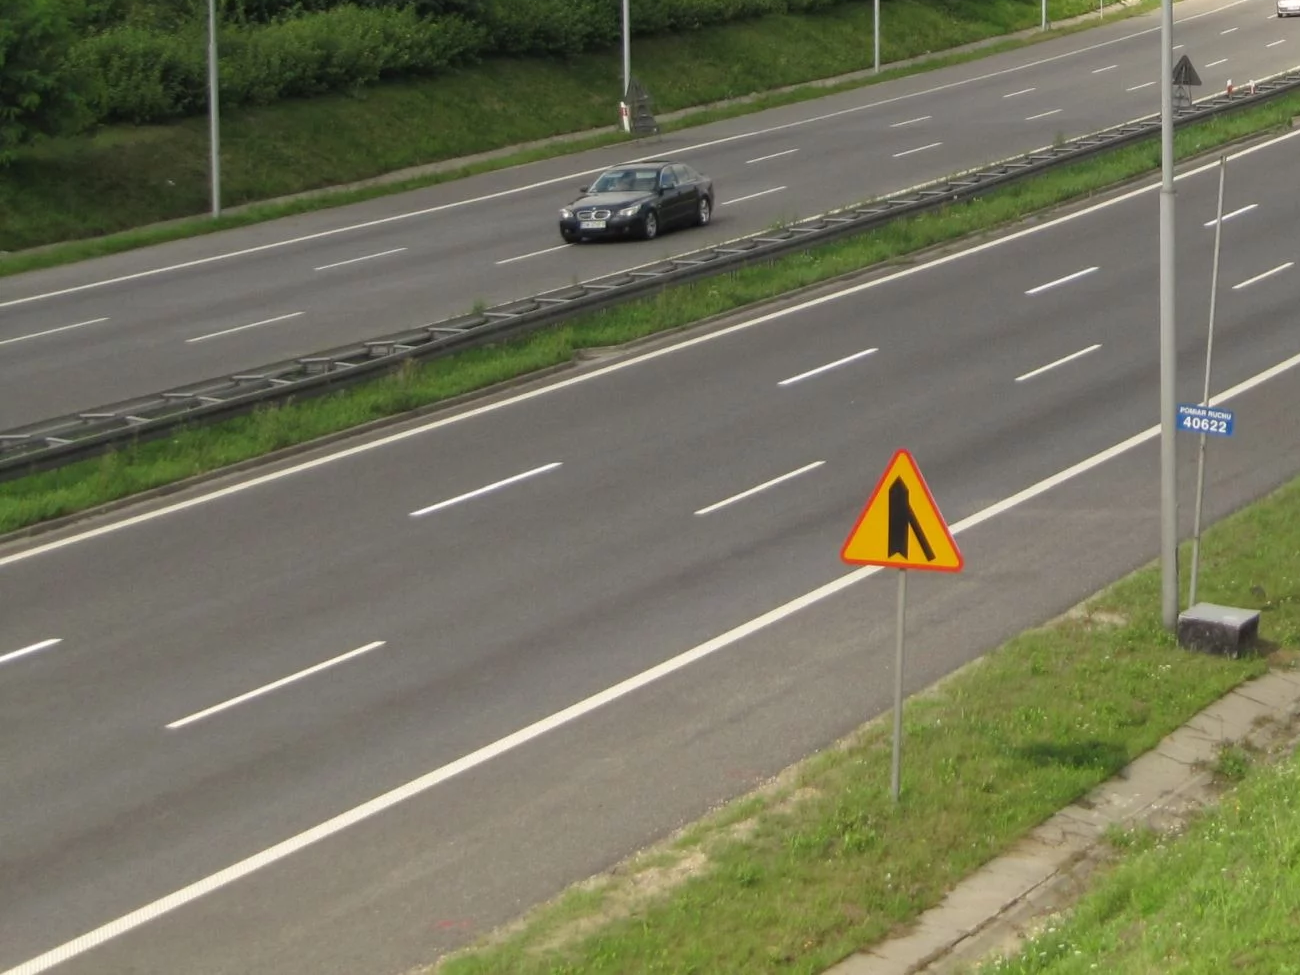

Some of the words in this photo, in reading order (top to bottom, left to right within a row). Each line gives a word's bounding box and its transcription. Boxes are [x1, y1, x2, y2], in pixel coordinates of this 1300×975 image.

[1180, 406, 1207, 416] POMIAR
[1208, 410, 1232, 420] RUCHU
[1183, 416, 1227, 433] 40622
